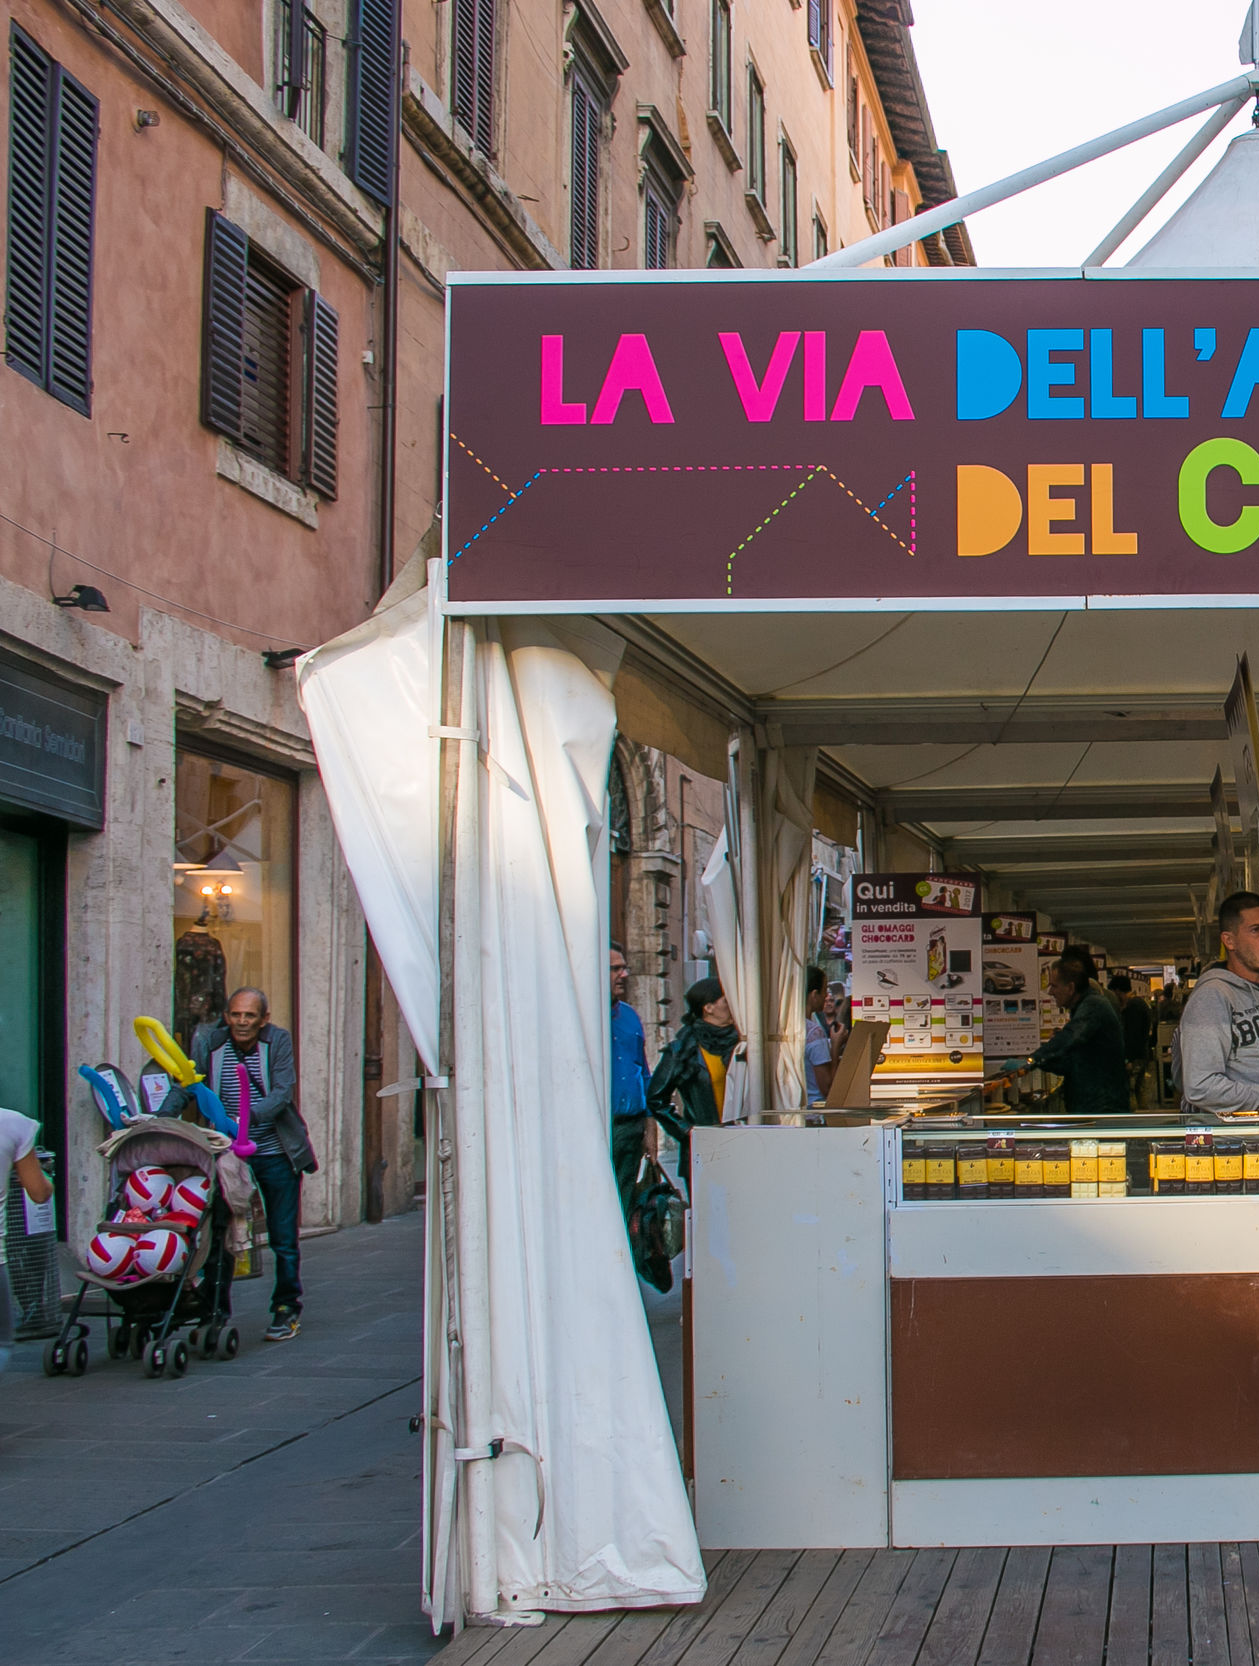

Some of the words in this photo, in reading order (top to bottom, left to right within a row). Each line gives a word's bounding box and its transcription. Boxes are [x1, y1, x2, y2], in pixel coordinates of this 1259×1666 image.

[541, 333, 675, 426] LA
[717, 329, 916, 425] VIA
[956, 463, 1140, 557] DEL
[856, 881, 895, 900] Qui
[856, 902, 867, 913] in
[871, 902, 916, 913] vendita
[861, 924, 875, 933] GLI
[877, 924, 915, 933] OMAGGI
[861, 934, 915, 944] CHOCOCARD
